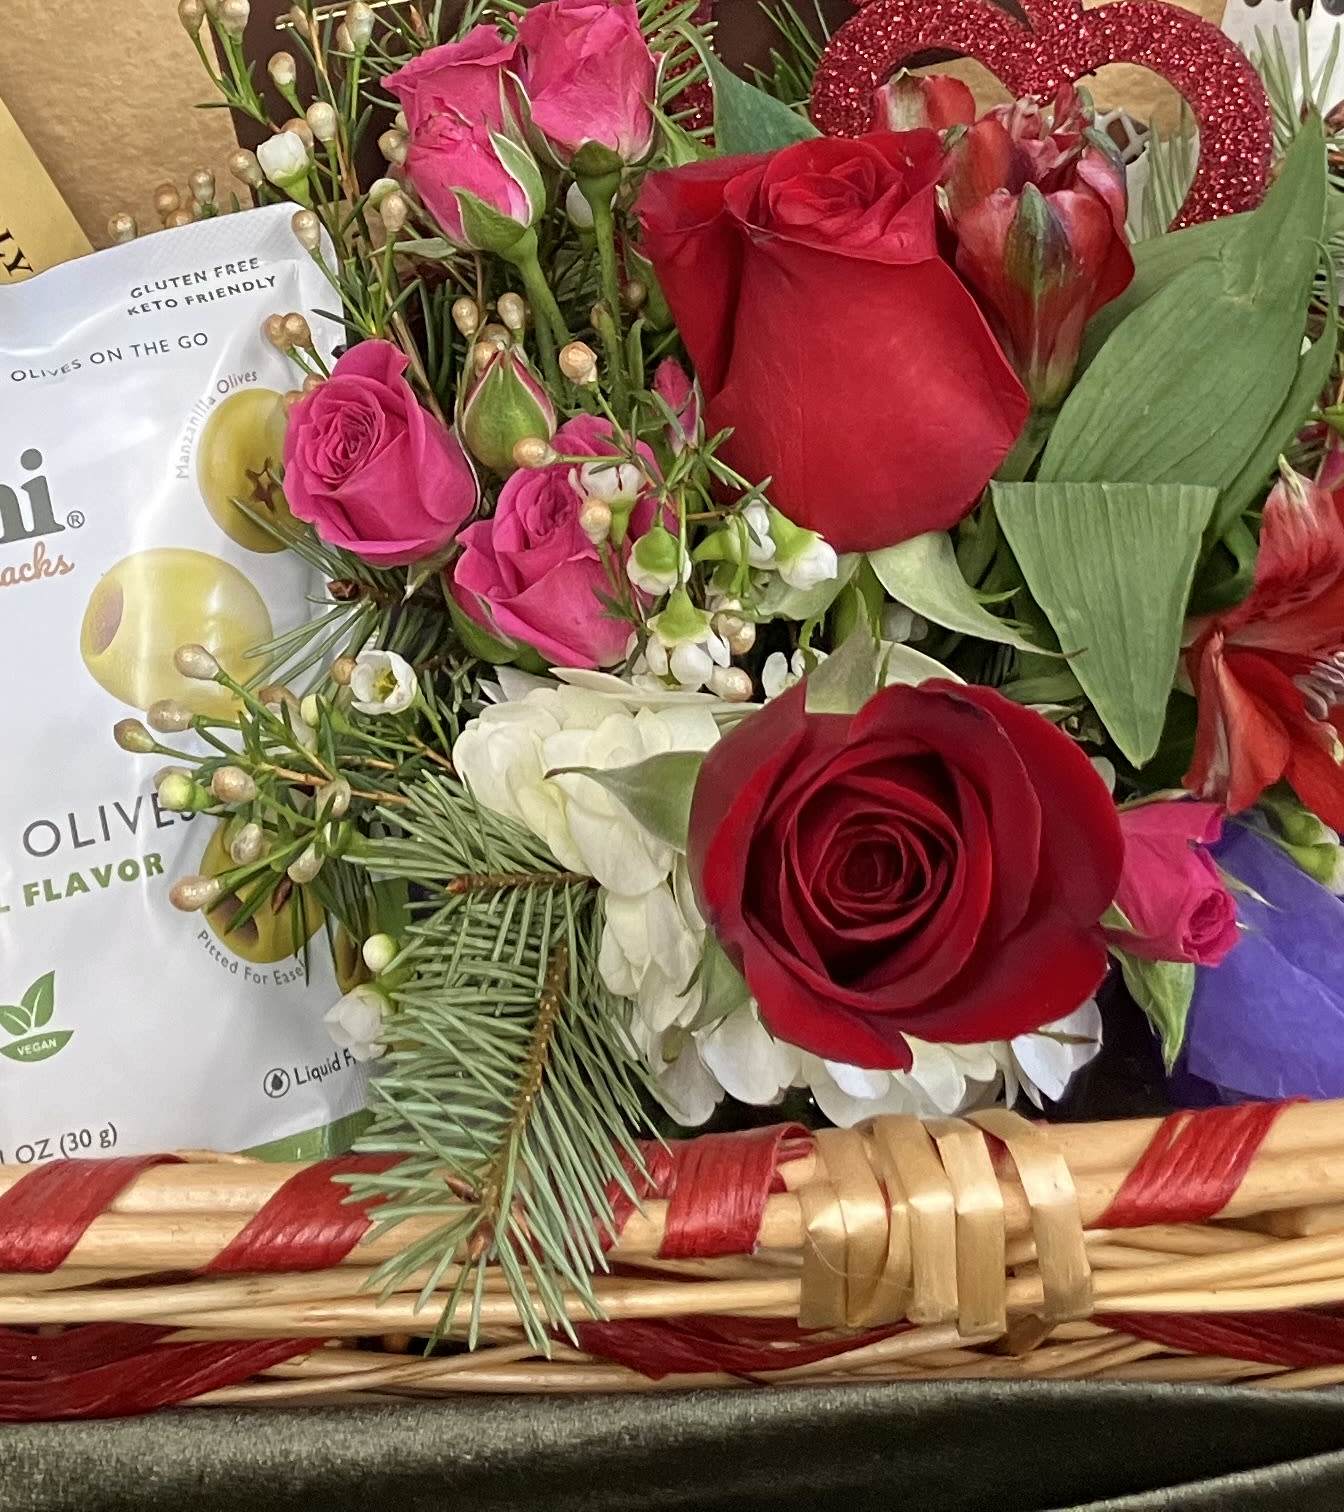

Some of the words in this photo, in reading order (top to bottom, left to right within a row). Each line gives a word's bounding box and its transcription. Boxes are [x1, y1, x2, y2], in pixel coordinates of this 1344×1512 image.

[127, 297, 179, 316] KETO
[185, 275, 277, 306] FRIENDLY
[130, 269, 207, 299] GLUTEN
[214, 257, 261, 279] FREE
[11, 358, 82, 383] OLIVES
[89, 347, 123, 365] ON
[129, 338, 171, 359] THE
[177, 332, 209, 350] GO
[175, 396, 217, 479] Manzanilla
[216, 370, 258, 394] Olives
[22, 852, 165, 908] FLAVOR
[197, 929, 239, 974] Pitted
[243, 966, 269, 985] For
[17, 1038, 58, 1057] VEGAN
[293, 1051, 342, 1086] Liquid
[15, 1137, 54, 1165] OZ
[58, 1129, 93, 1161] (30
[98, 1121, 118, 1149] g)
